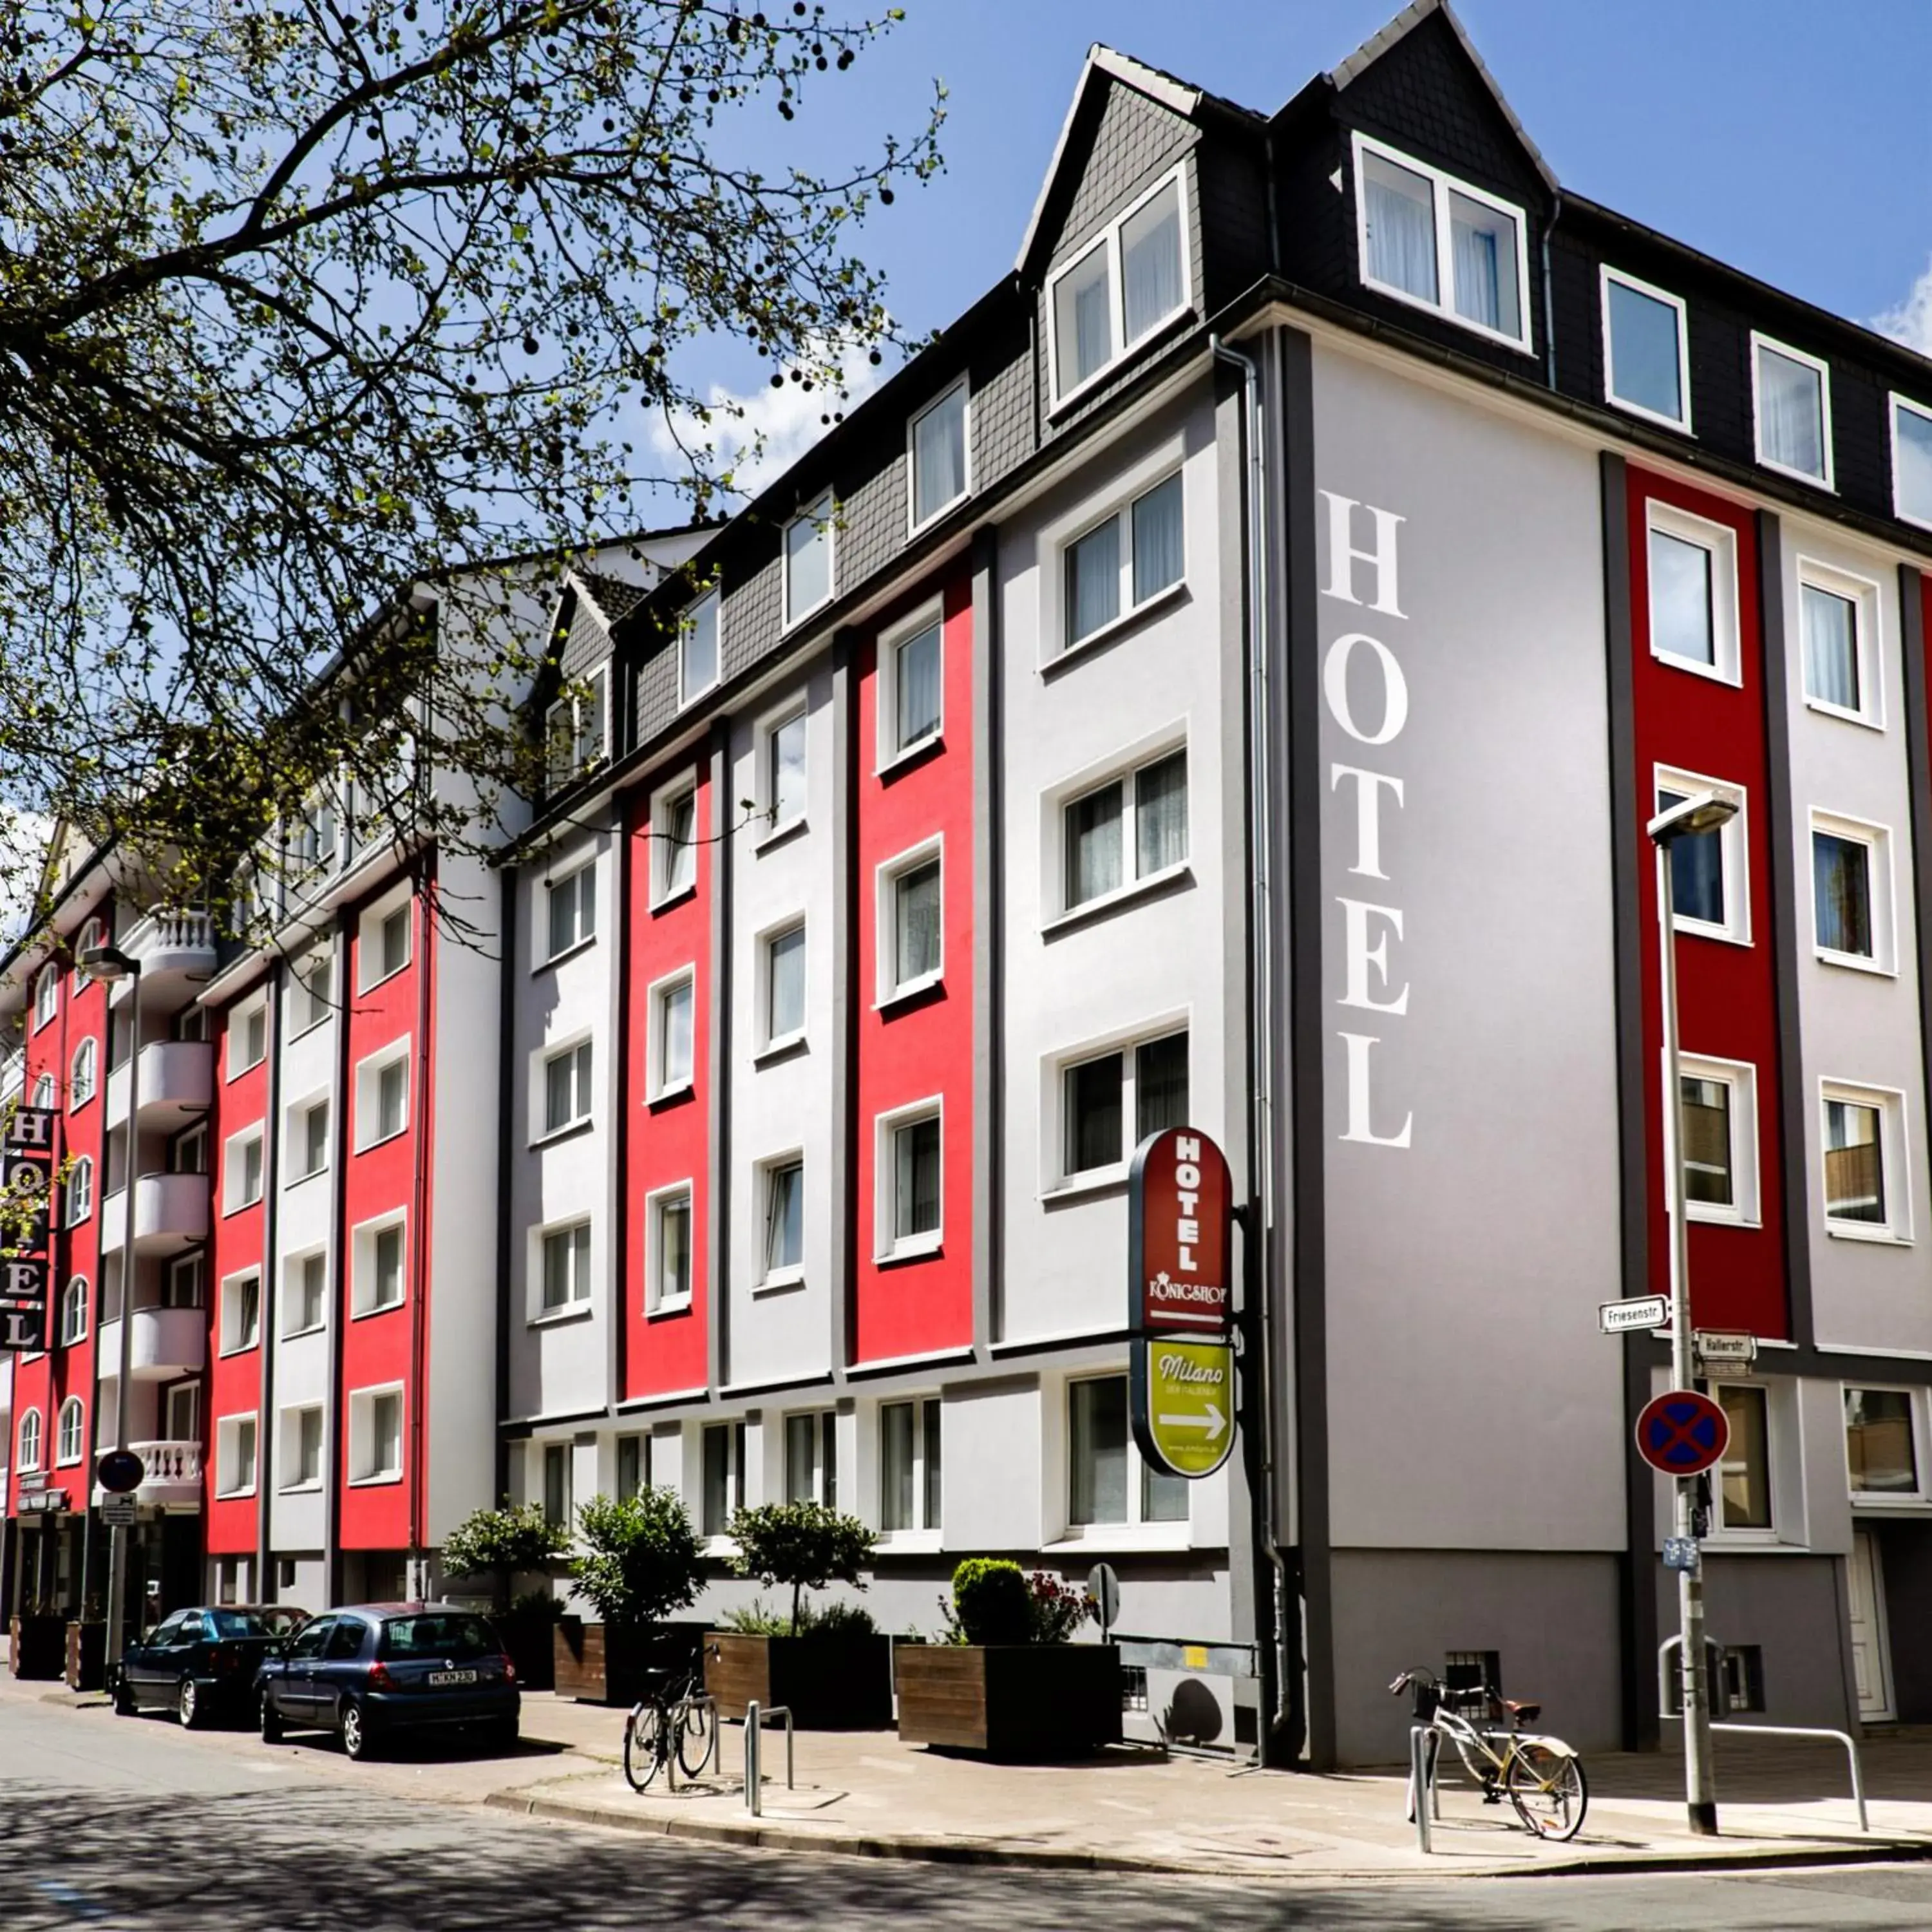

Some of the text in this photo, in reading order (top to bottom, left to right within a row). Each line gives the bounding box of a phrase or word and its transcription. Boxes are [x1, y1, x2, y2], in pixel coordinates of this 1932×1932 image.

[1317, 488, 1413, 1149] HOTEL
[1175, 1135, 1200, 1271] HOTEL
[1159, 1354, 1223, 1383] Milano
